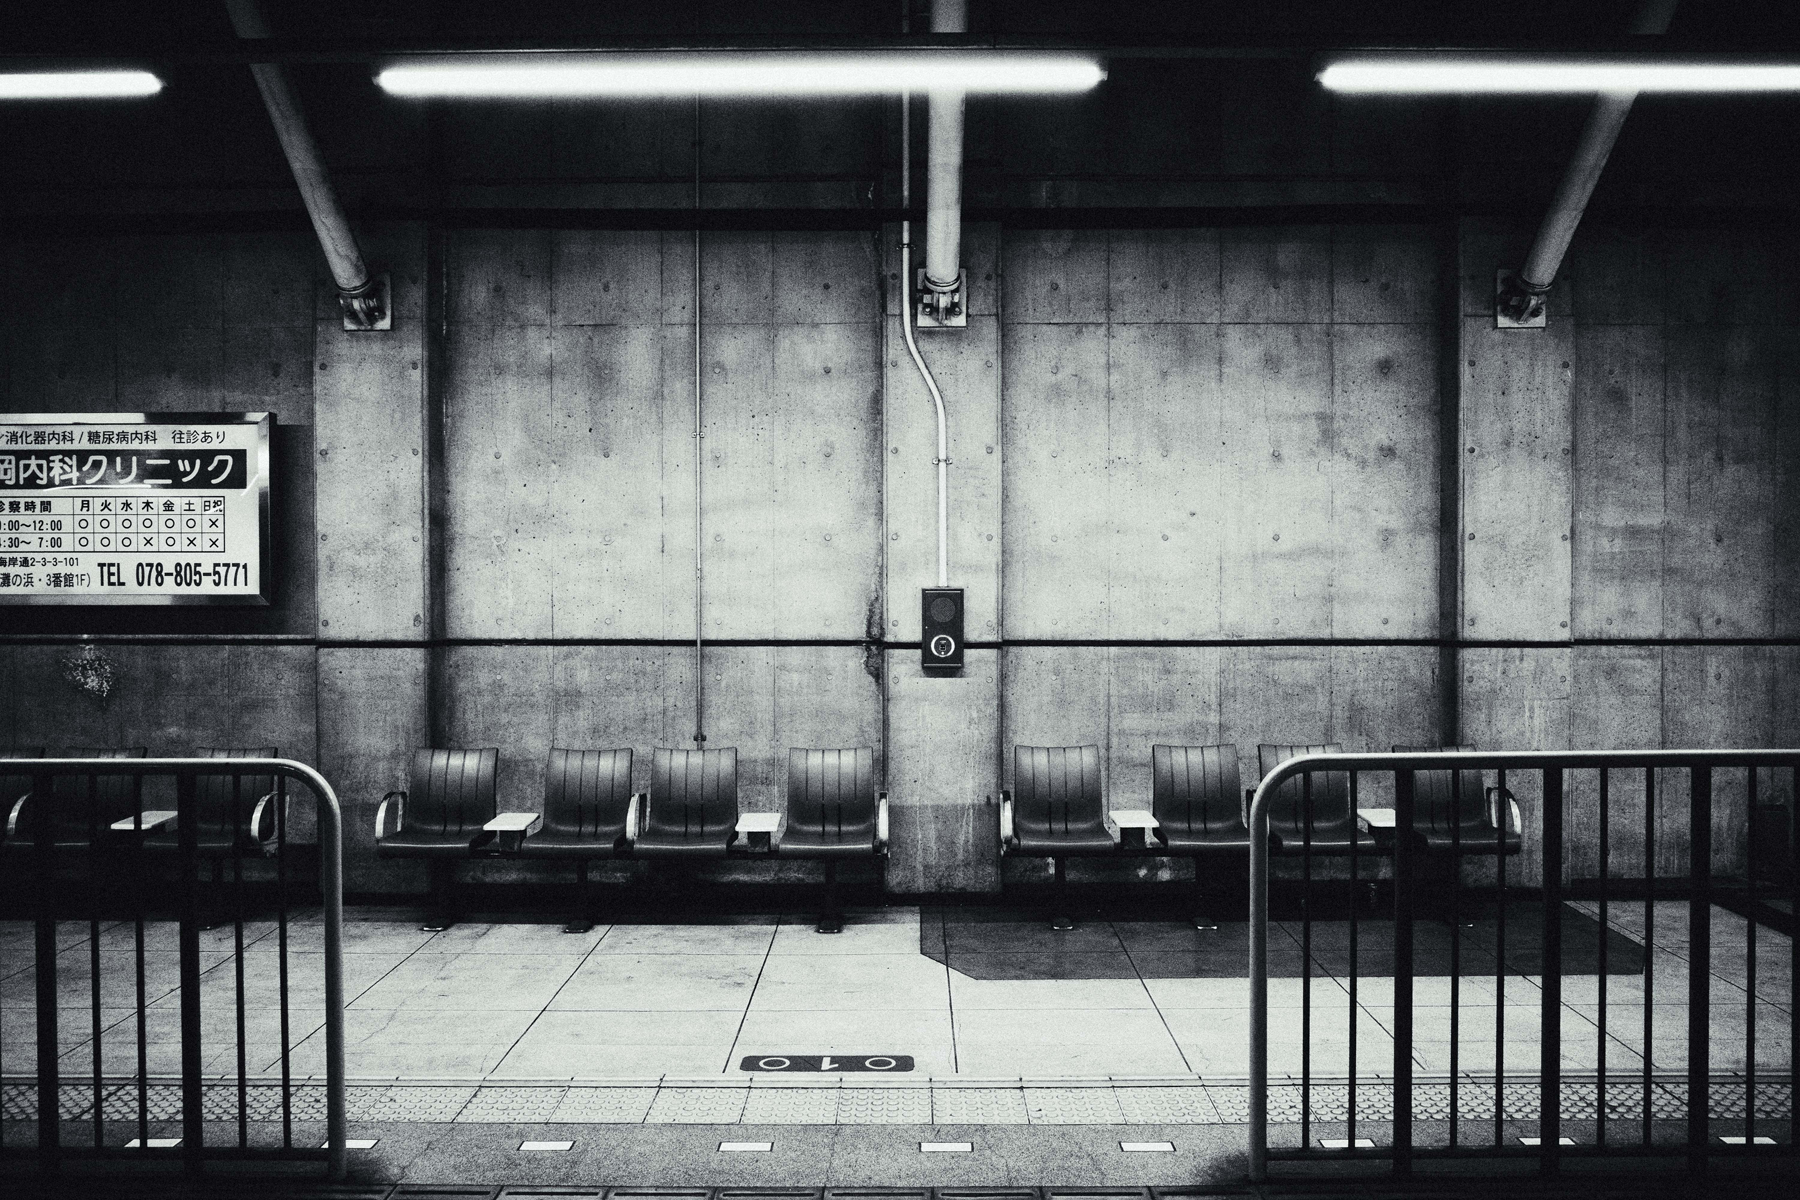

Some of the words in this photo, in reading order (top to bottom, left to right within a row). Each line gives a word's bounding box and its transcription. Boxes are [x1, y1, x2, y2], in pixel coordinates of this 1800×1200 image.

[87, 430, 158, 445] 糖尿病内科
[171, 430, 227, 445] 往診あり
[80, 499, 91, 512] 月
[100, 499, 113, 512] 火
[120, 499, 133, 512] 水
[141, 499, 154, 512] 木
[162, 499, 175, 512] 金
[183, 499, 196, 512] 土
[0, 519, 63, 532] :00～12:00
[38, 536, 63, 549] 7:00
[97, 562, 126, 587] TEL
[135, 562, 249, 587] 078-805-5771
